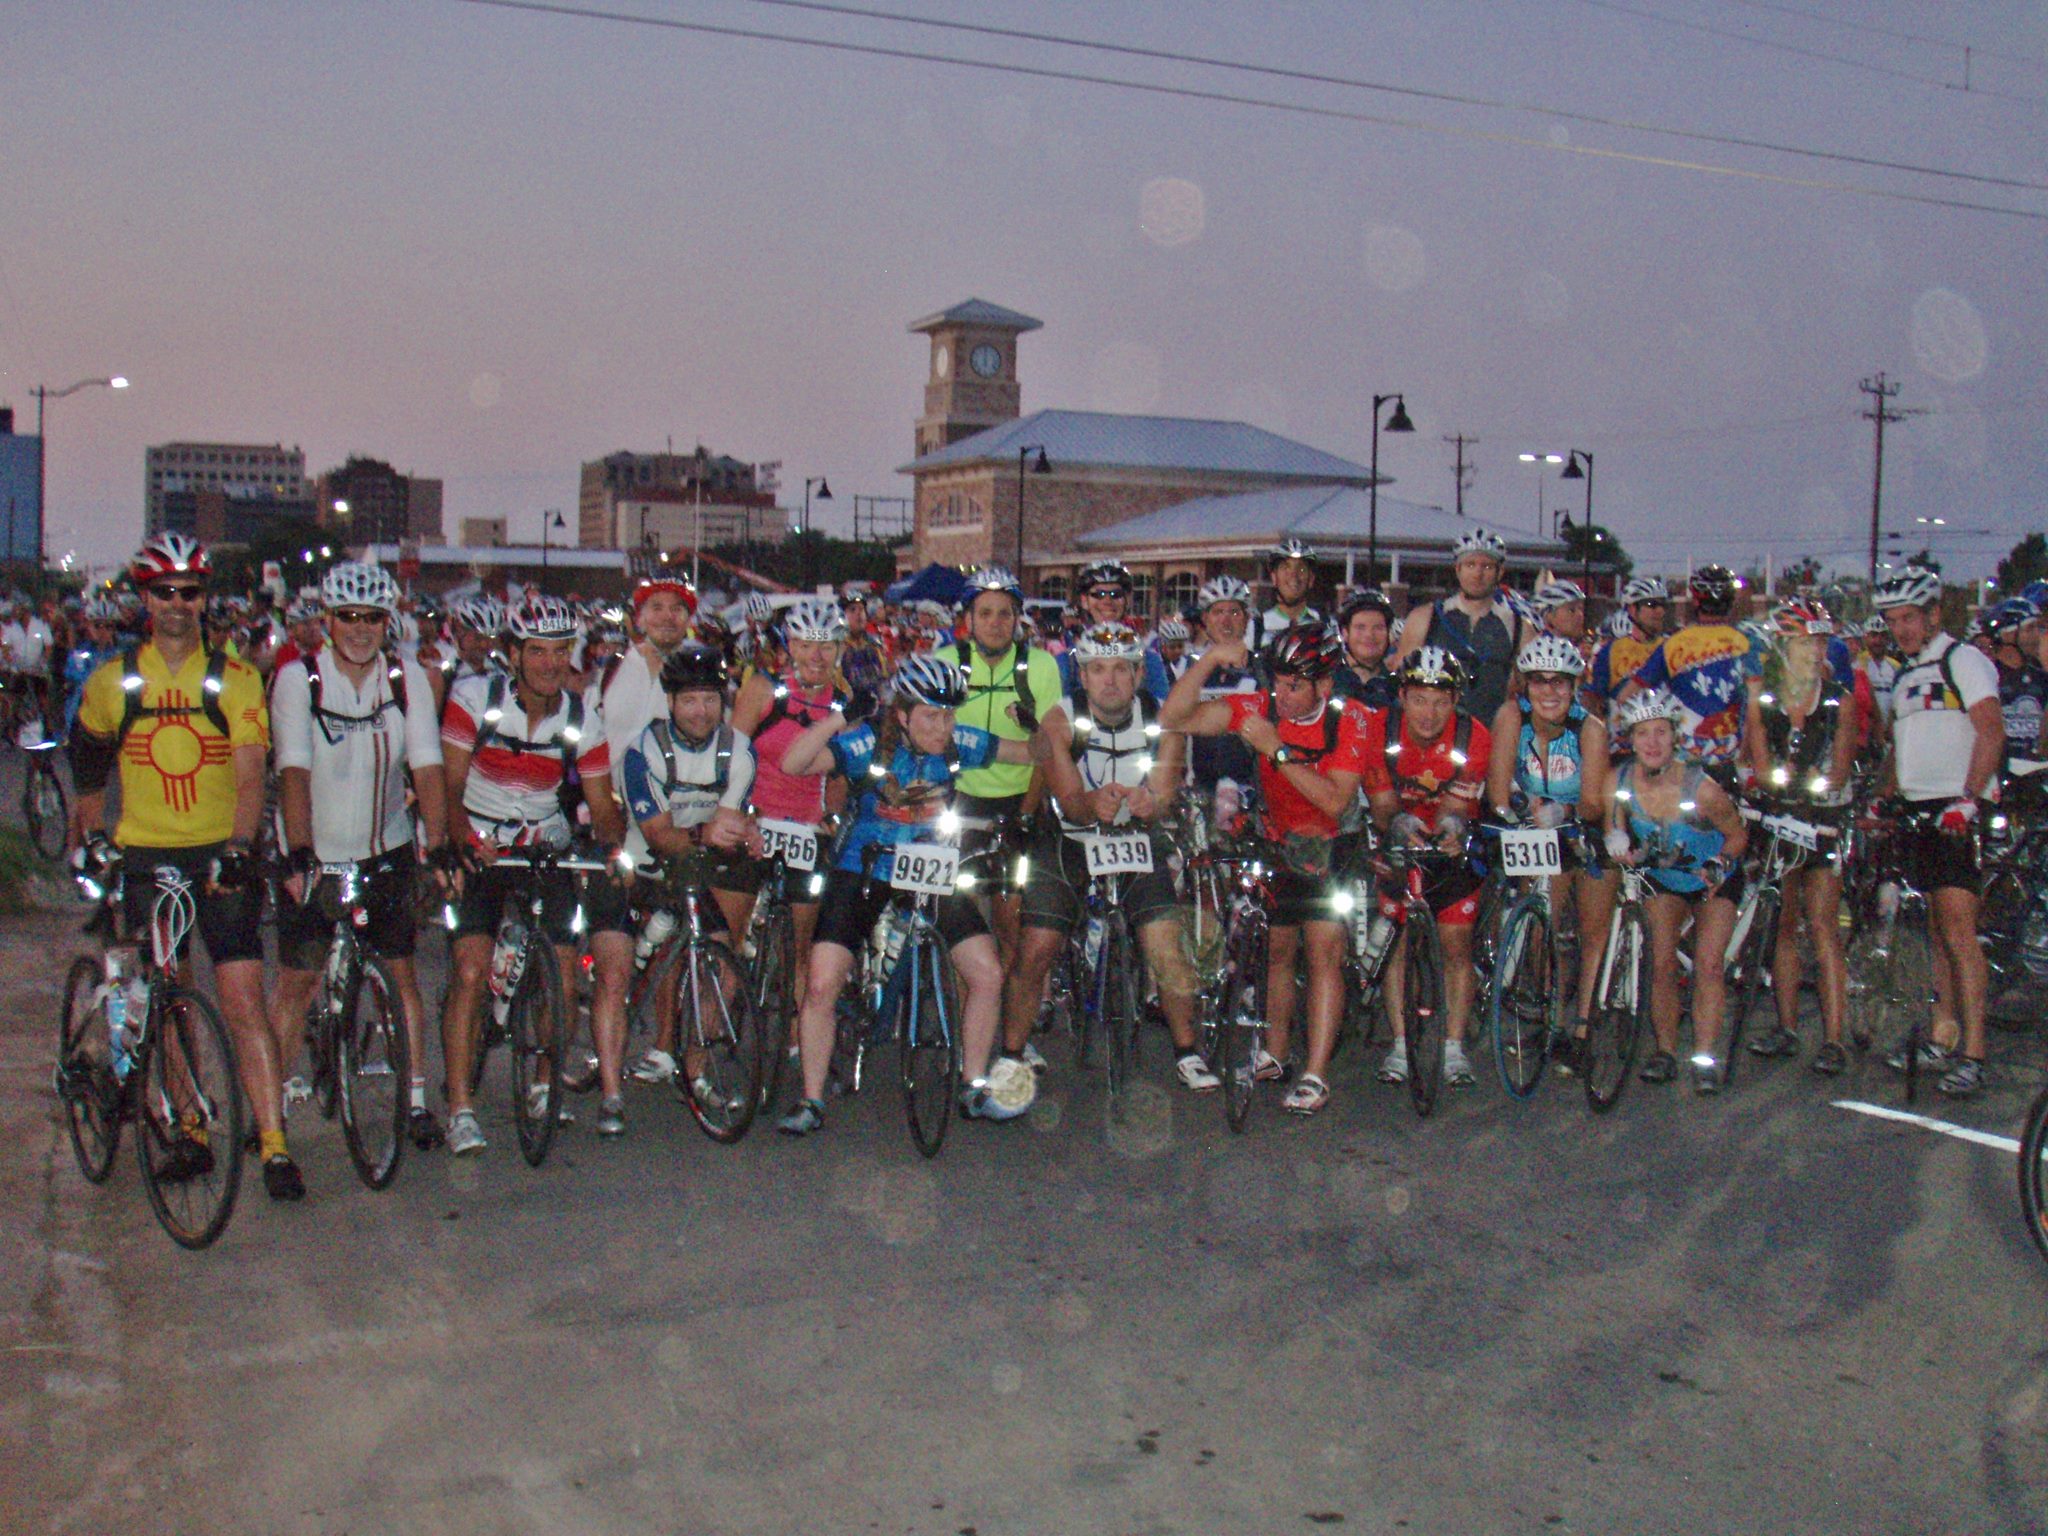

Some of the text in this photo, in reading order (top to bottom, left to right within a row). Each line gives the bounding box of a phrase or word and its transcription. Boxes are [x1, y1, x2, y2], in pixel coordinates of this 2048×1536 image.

[805, 628, 829, 640] 3556
[1095, 644, 1119, 656] 1339
[1535, 657, 1559, 668] 5310
[761, 828, 816, 862] 3556
[1091, 841, 1149, 868] 1339
[1504, 841, 1559, 868] 5310
[895, 854, 954, 887] 9921
